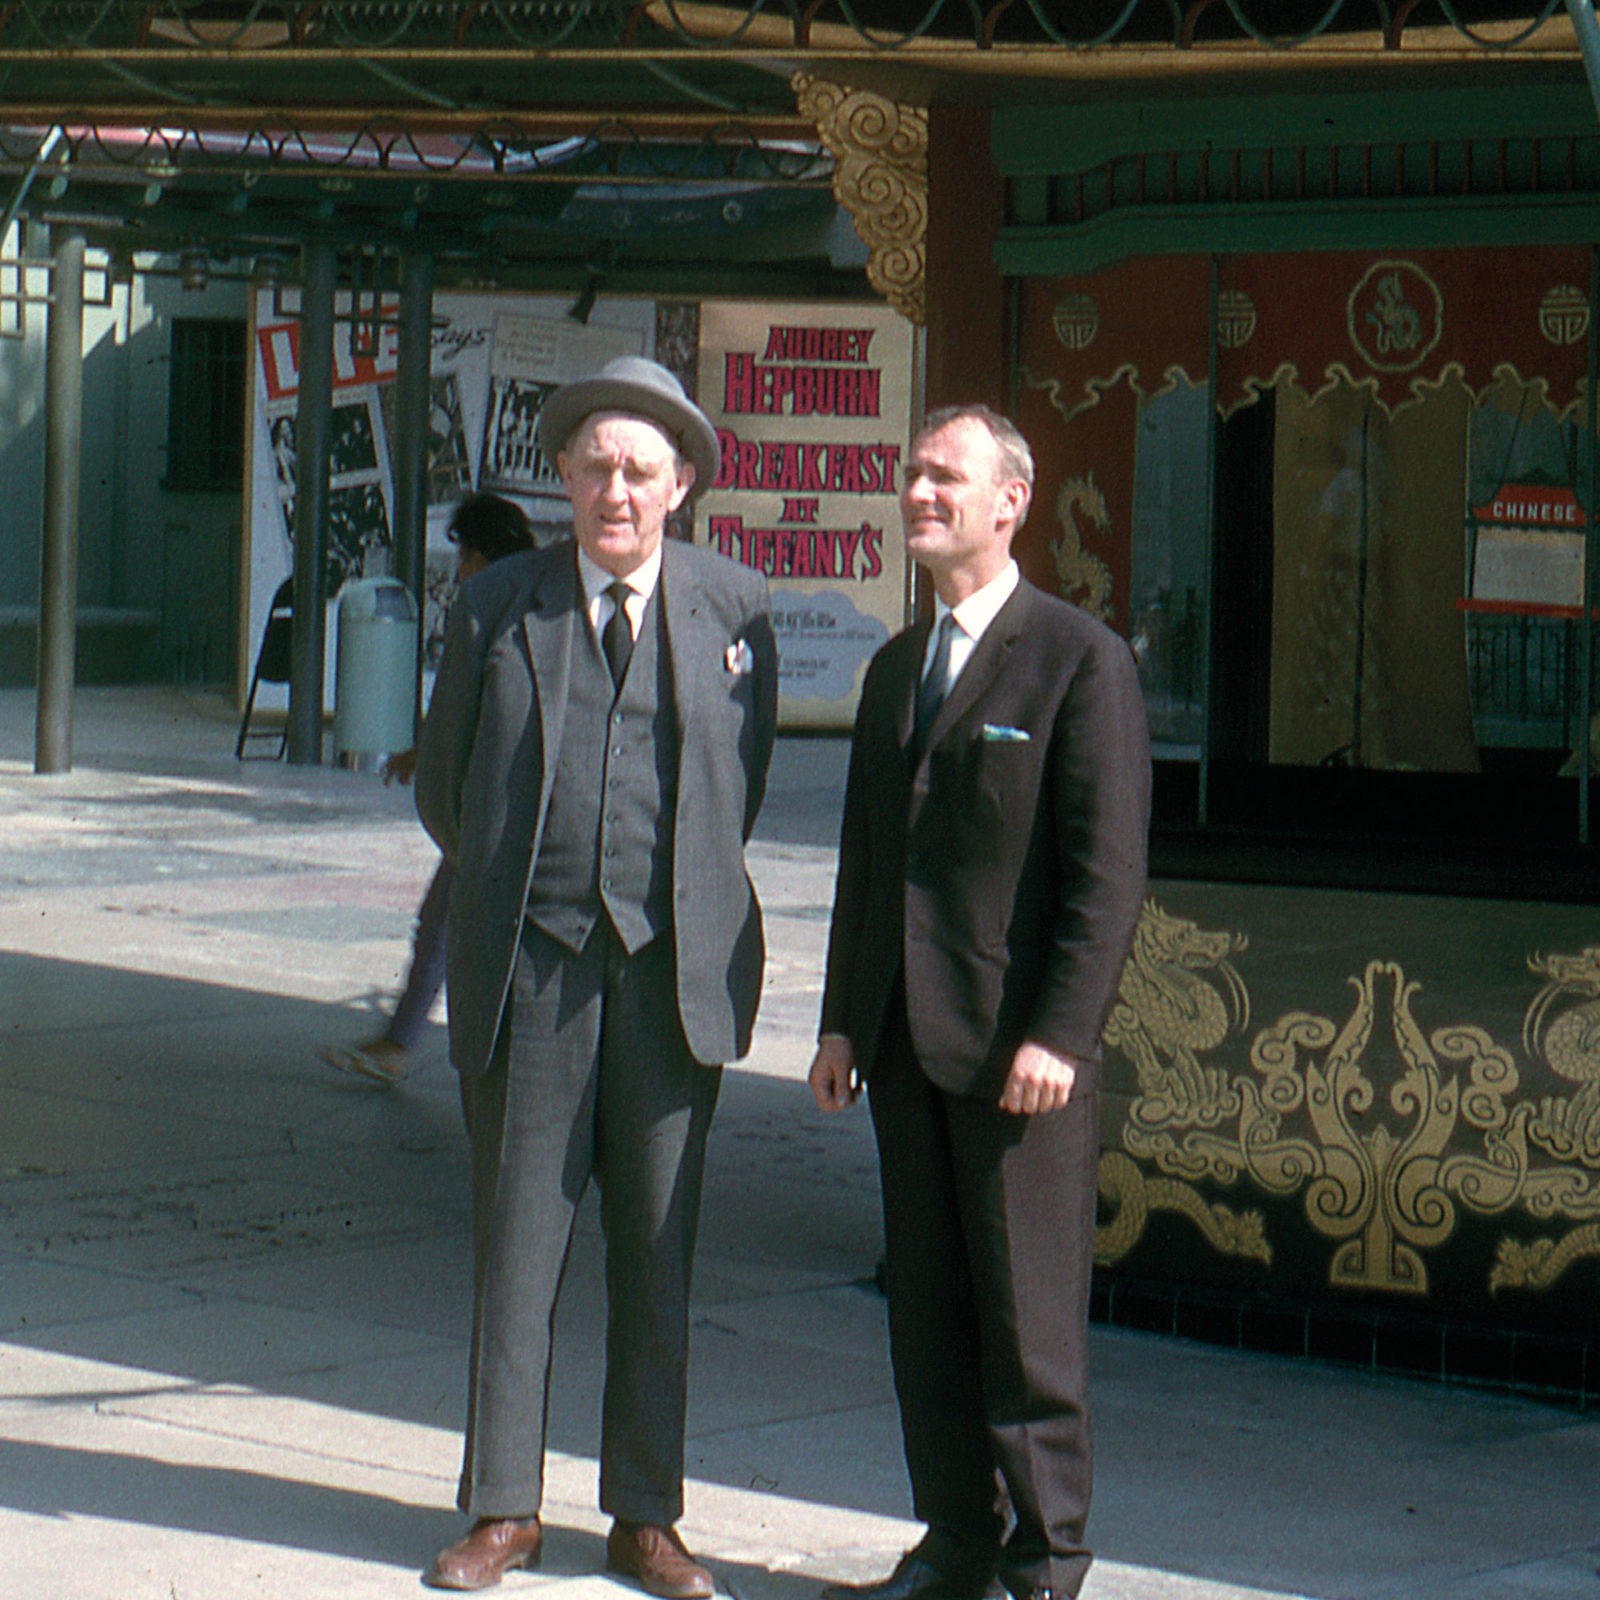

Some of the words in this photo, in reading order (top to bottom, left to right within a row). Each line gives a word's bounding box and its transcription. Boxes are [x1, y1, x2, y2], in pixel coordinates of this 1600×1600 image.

[270, 312, 400, 391] LFE
[764, 325, 875, 363] AUDREY
[723, 352, 882, 417] HEPBURN
[711, 427, 901, 495] BREAKFAST
[779, 496, 820, 523] AT
[1492, 501, 1576, 521] CHINESE
[708, 514, 883, 582] TIFFANY'S
